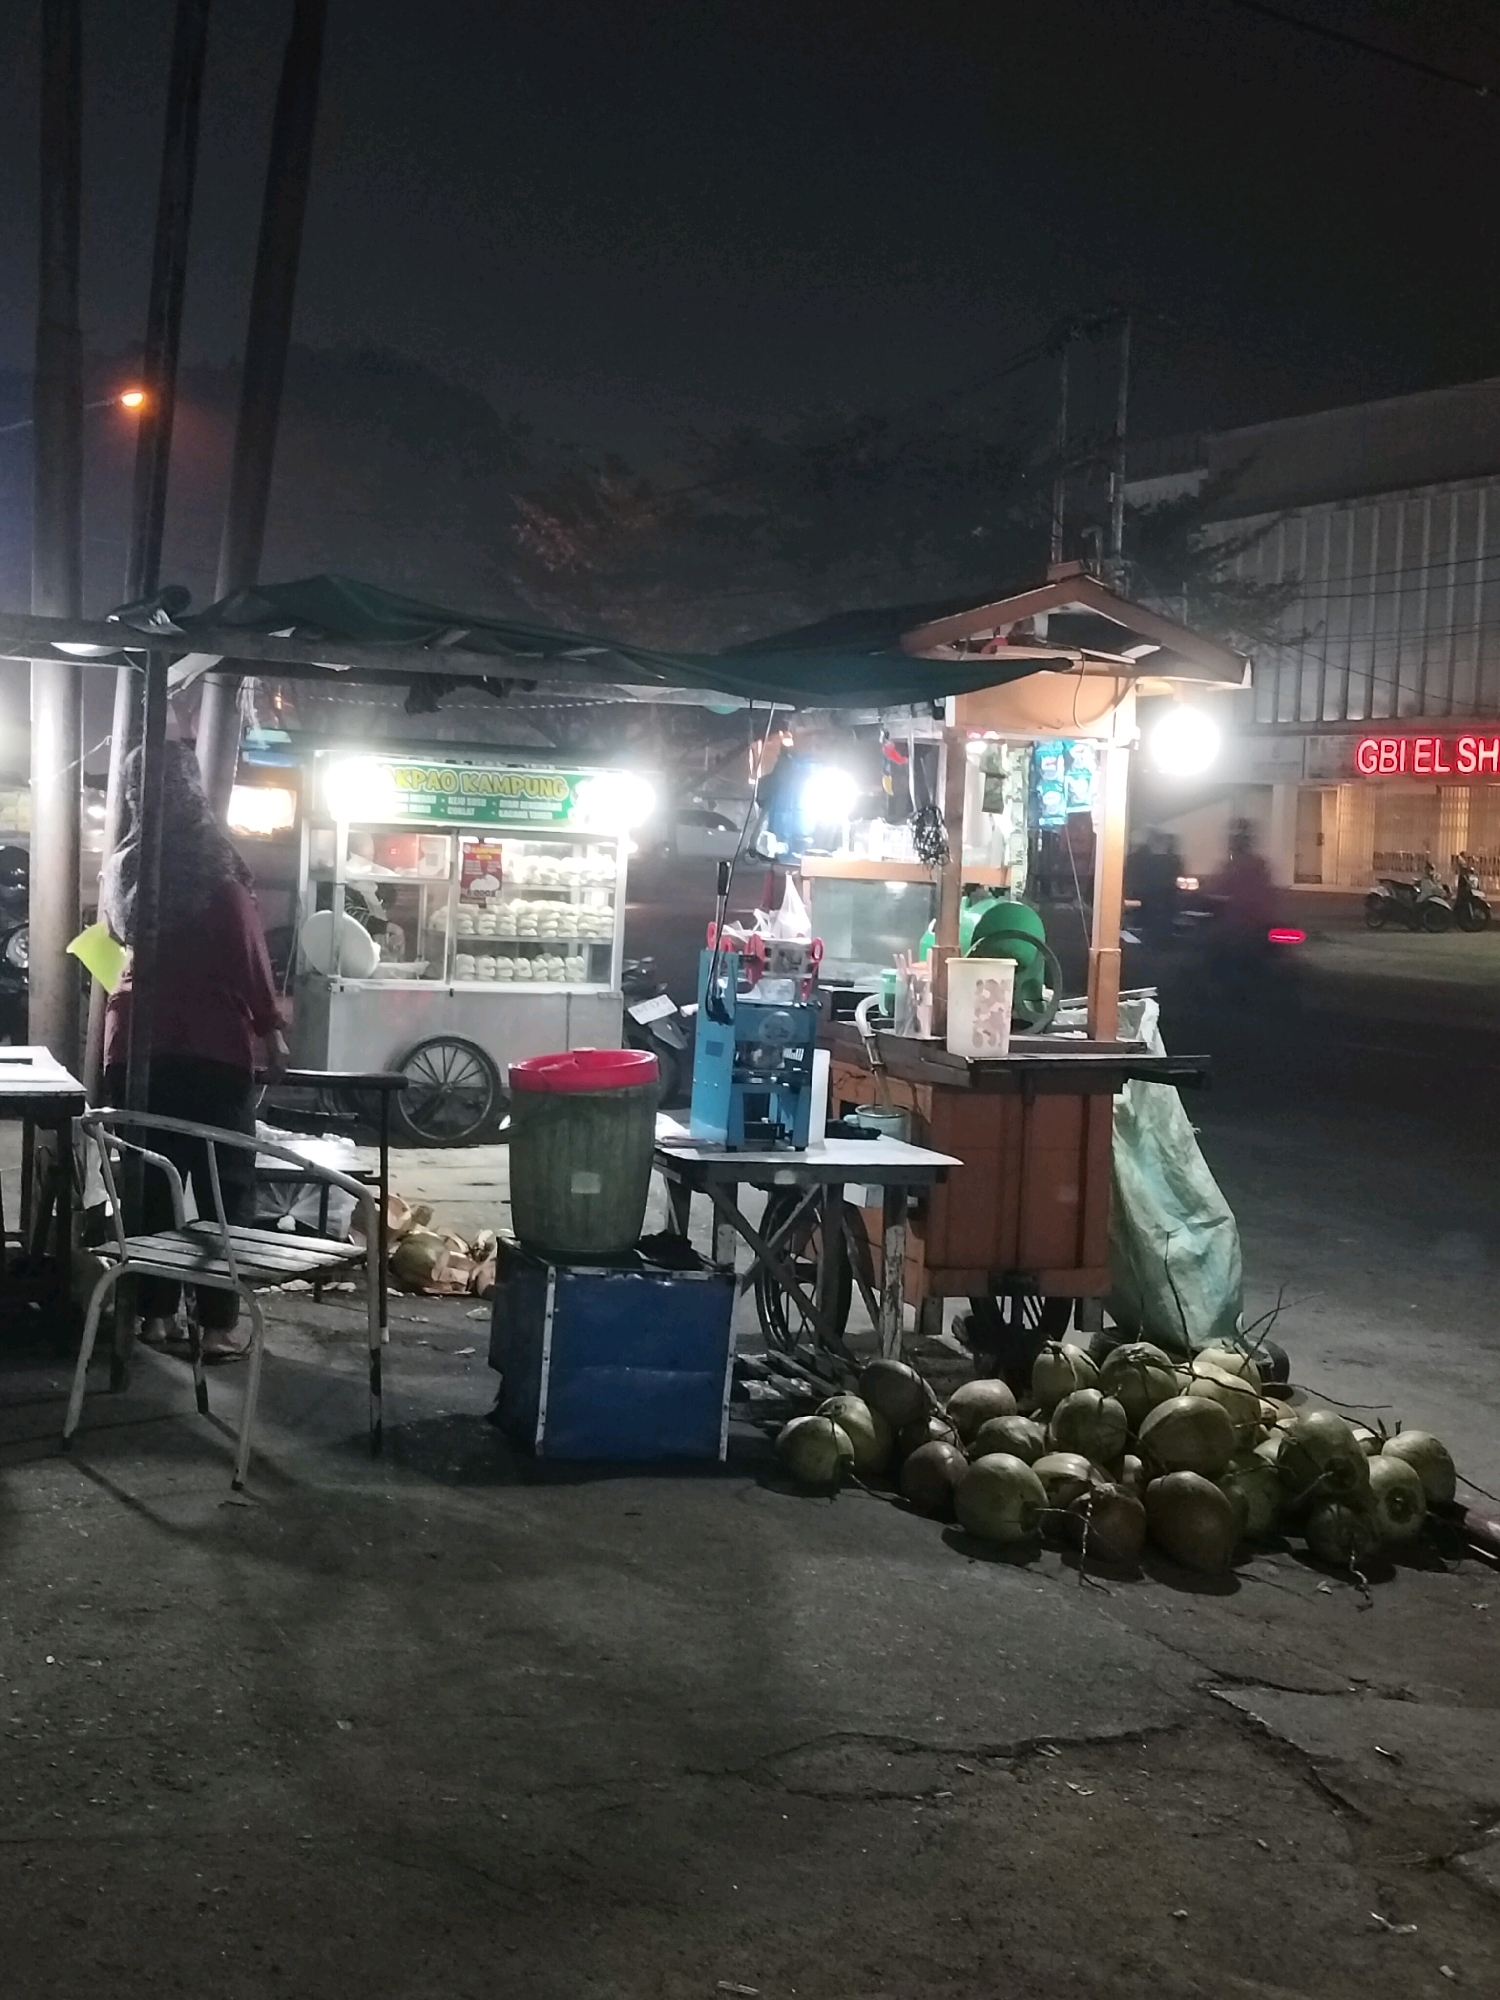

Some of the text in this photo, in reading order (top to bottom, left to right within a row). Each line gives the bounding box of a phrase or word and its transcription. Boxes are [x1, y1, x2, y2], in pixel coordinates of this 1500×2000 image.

[1357, 738, 1406, 773] GBI
[1414, 738, 1451, 773] EL
[461, 773, 568, 798] KAMPUNG
